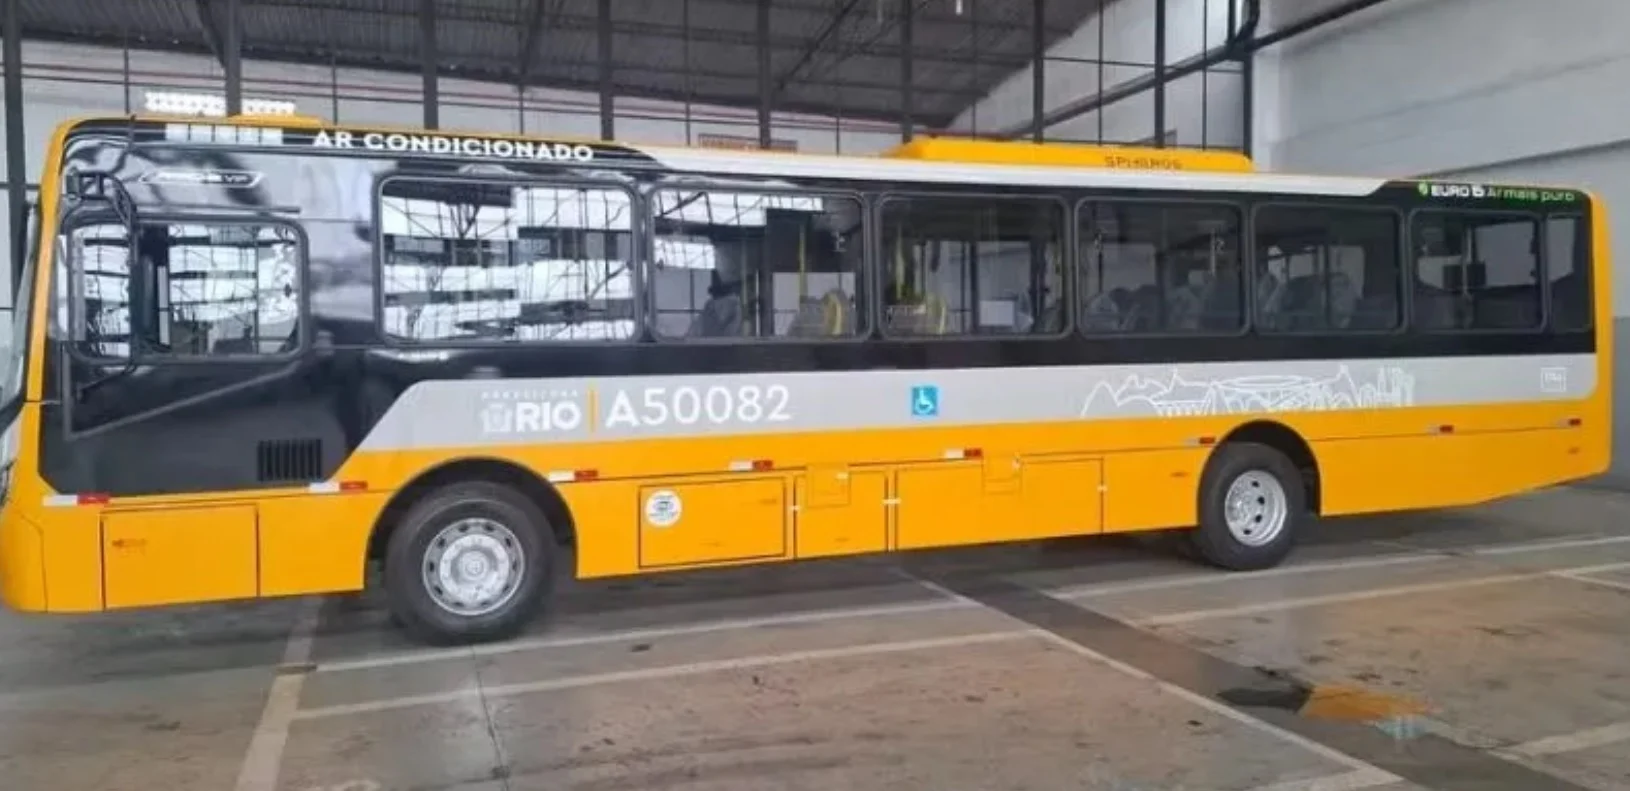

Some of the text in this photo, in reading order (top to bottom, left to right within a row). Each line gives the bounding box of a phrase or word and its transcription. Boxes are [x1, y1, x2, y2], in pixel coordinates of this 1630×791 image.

[312, 130, 594, 162] AR CONDICIONADO
[1431, 184, 1469, 197] EURO
[1503, 188, 1539, 200] mais
[1541, 191, 1576, 203] puro
[516, 401, 582, 432] RIO
[605, 384, 792, 429] A50082
